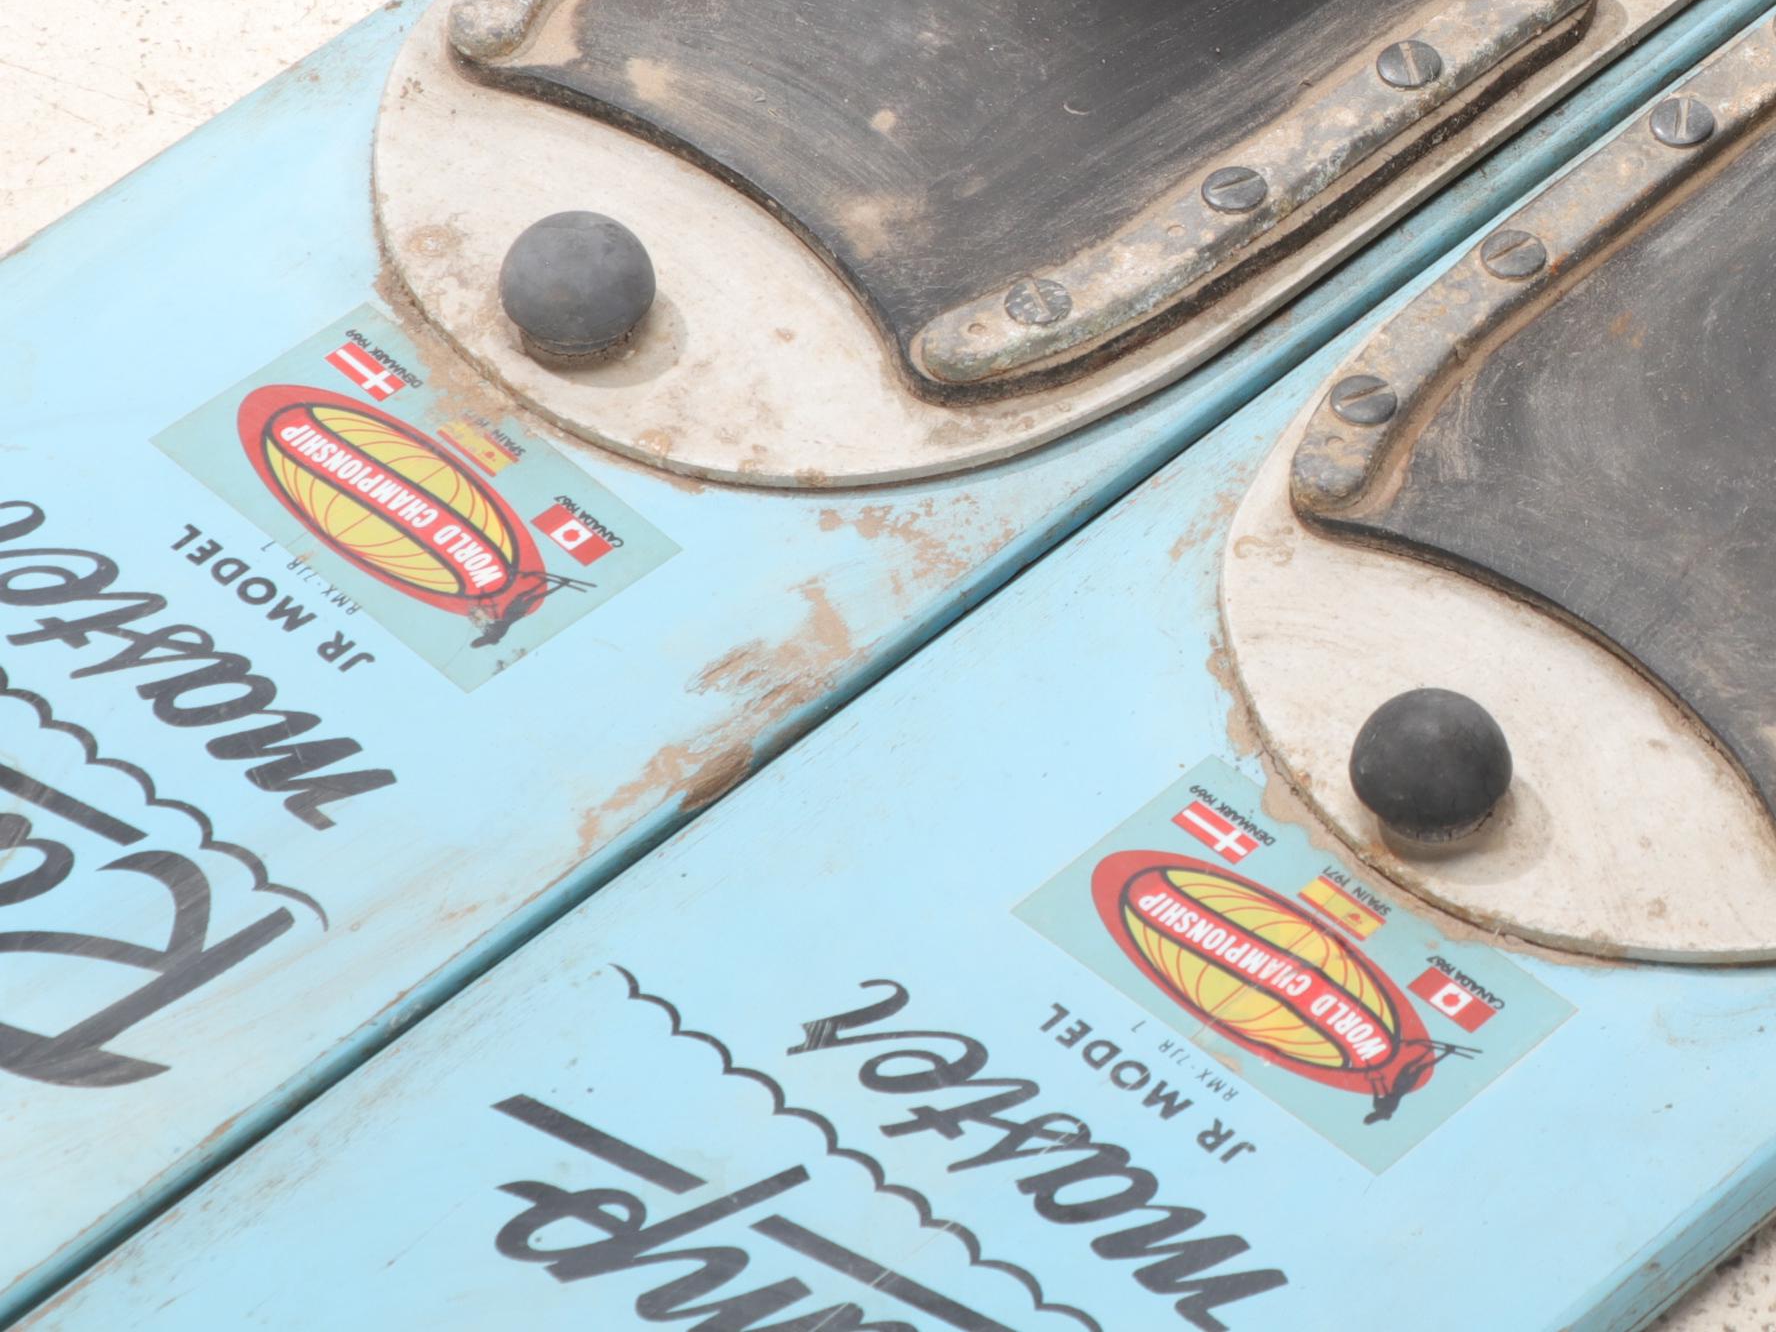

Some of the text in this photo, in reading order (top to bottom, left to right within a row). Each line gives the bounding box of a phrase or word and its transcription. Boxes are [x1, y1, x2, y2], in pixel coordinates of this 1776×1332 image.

[345, 329, 424, 389] DENMARK 1969
[280, 424, 505, 590] WORLD CHAMPIONSHIP
[553, 495, 624, 549] CANADA 1967
[170, 523, 376, 673] JR MODEL
[1188, 784, 1277, 847] DENMARK 1969
[1322, 865, 1392, 917] SPAIN 1971
[1138, 892, 1389, 1062] WORLD CHAMPIONSHIP
[1425, 955, 1505, 1010] CANADA 1967
[1038, 1001, 1257, 1164] JR MODEL
